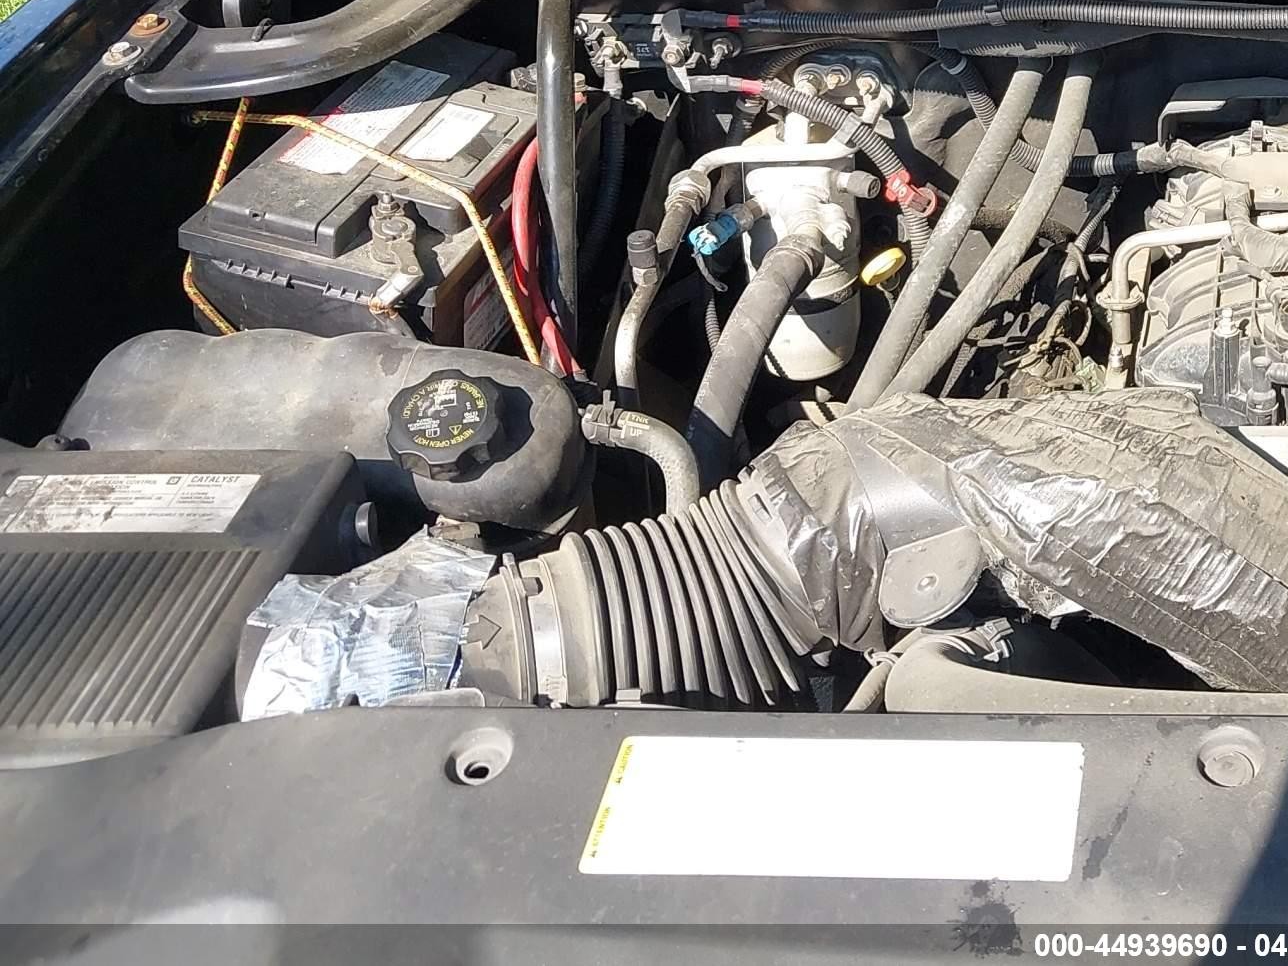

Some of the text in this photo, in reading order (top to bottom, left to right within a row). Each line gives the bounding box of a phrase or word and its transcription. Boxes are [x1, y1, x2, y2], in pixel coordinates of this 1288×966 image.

[450, 428, 474, 444] NEVER
[429, 439, 450, 448] OPEN
[190, 475, 241, 483] CATALYST
